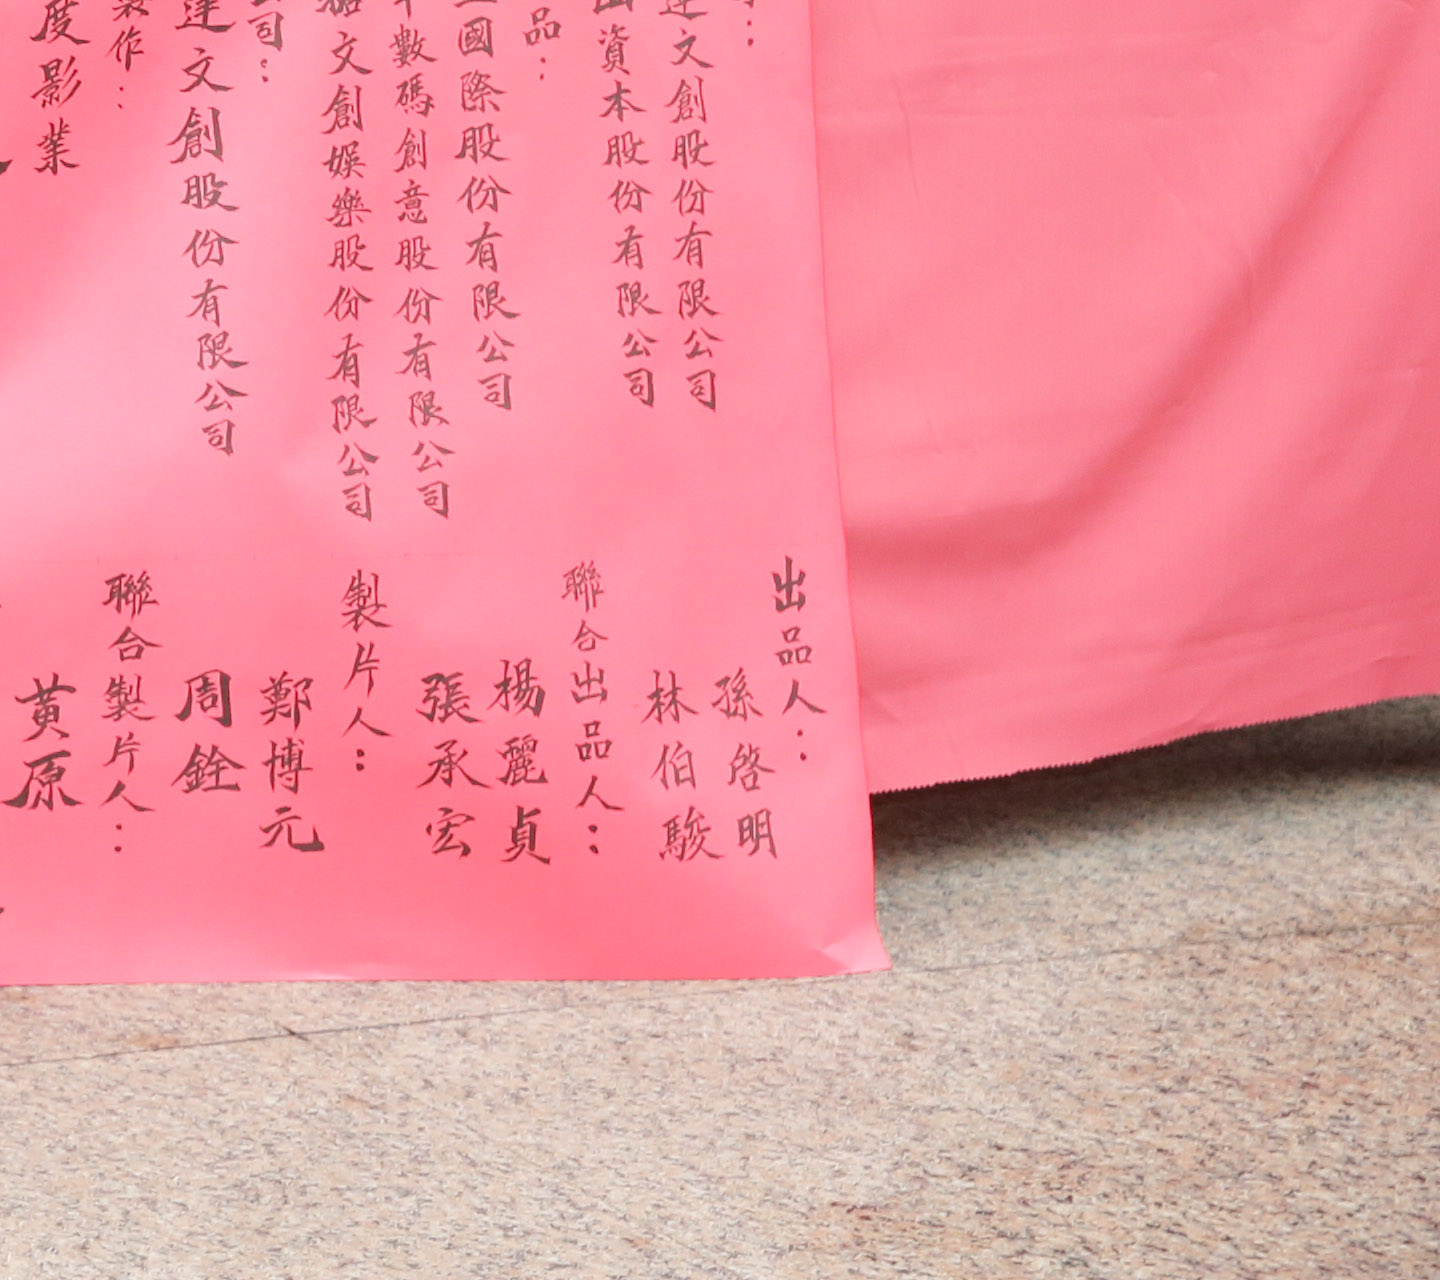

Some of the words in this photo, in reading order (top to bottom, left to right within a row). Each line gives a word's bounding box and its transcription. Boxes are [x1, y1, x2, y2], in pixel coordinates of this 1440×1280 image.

[102, 571, 160, 852] 聯合製片人：
[172, 669, 244, 793] 周銓
[342, 570, 390, 771] 製片人：
[563, 563, 622, 854] 聯合出品人：
[772, 555, 827, 762] 出品人：
[260, 671, 325, 852] 鄭博元
[418, 672, 489, 856] 張承宏
[492, 658, 550, 864] 楊麗貞
